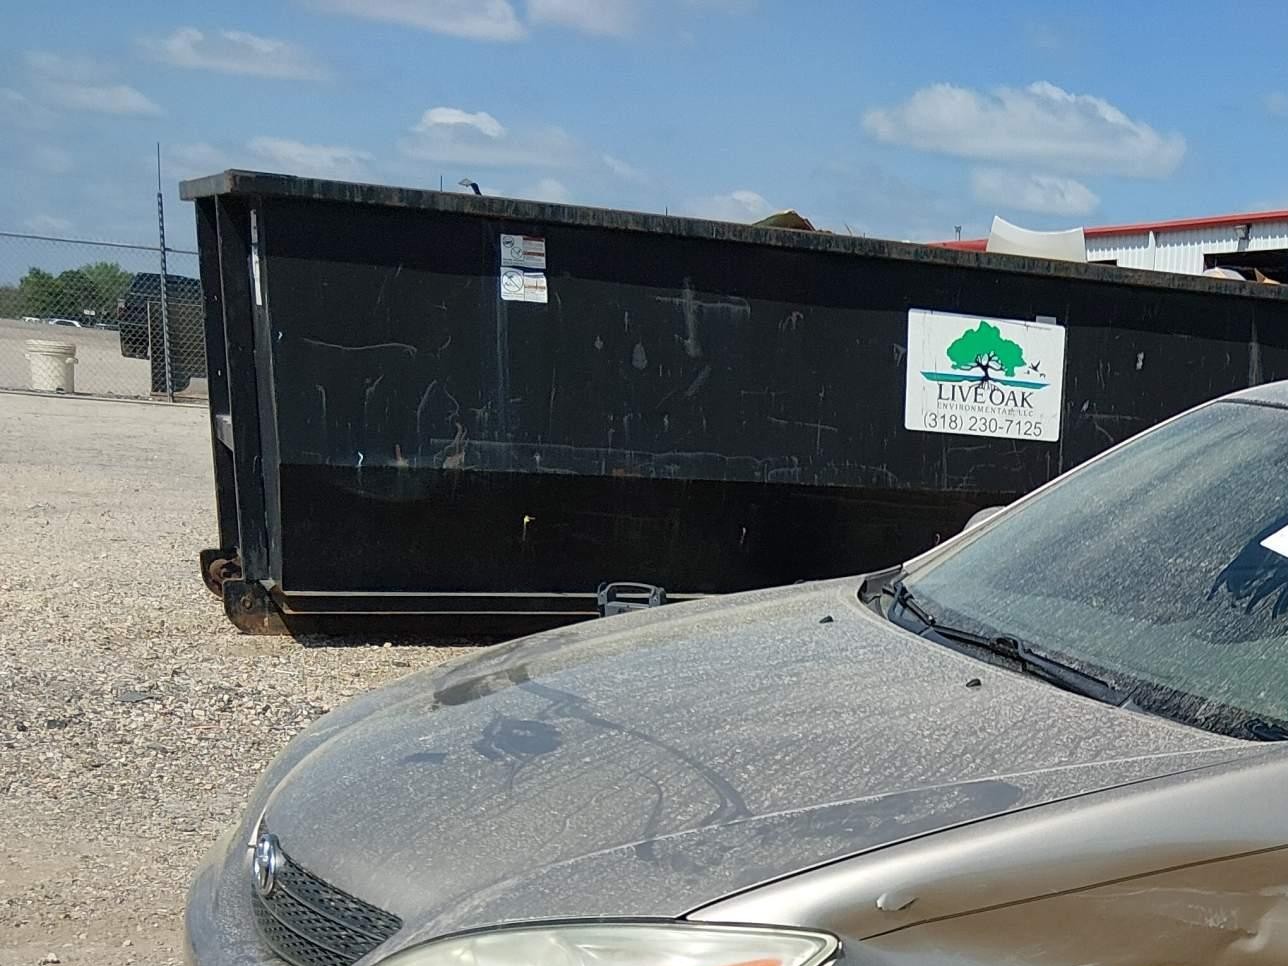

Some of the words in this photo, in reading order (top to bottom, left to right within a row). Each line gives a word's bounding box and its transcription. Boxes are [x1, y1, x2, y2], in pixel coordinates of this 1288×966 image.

[938, 383, 986, 404] LIVE
[989, 388, 1034, 409] OAK
[924, 412, 963, 429] (318)
[968, 416, 1042, 437] 230-7125
[1018, 410, 1034, 418] LLC
